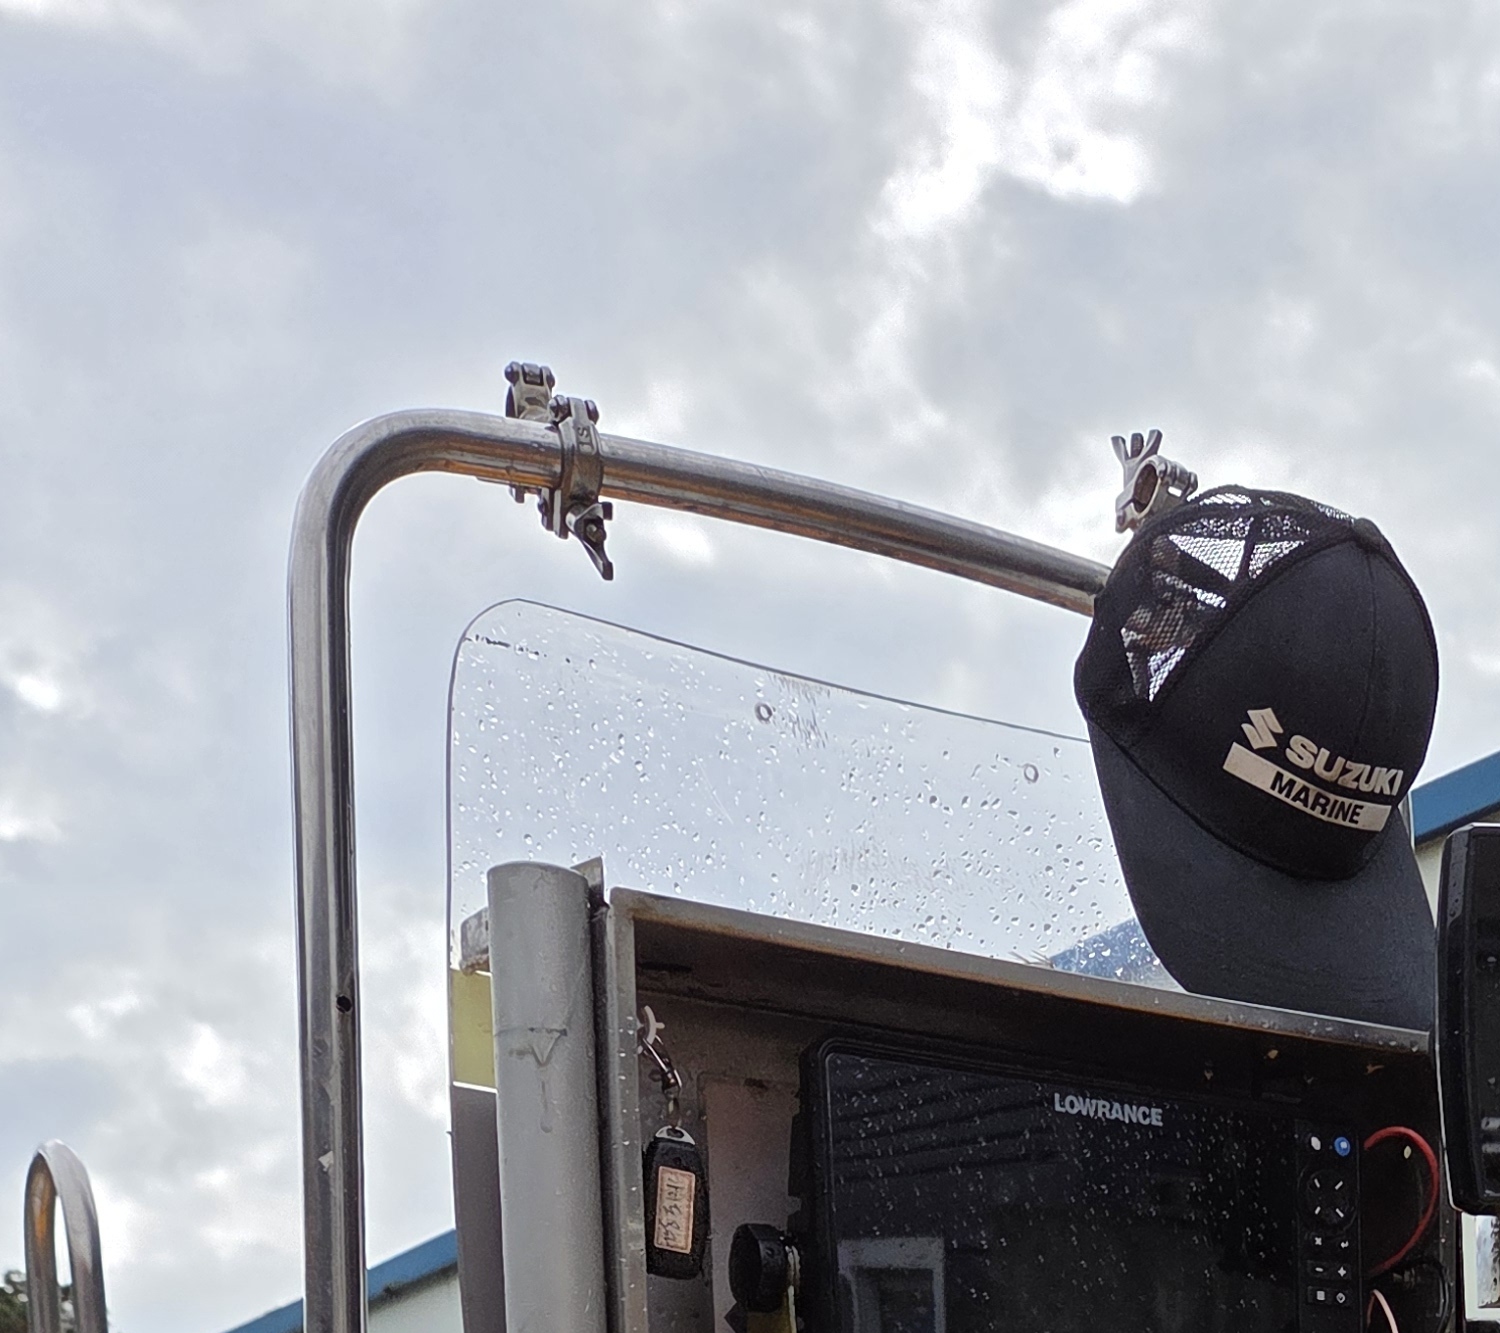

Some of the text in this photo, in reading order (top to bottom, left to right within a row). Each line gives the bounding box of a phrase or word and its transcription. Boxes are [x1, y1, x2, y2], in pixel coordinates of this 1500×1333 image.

[1285, 734, 1404, 796] SUZUKI
[1269, 771, 1365, 825] MARINE
[1053, 1091, 1164, 1128] LOWRANCE
